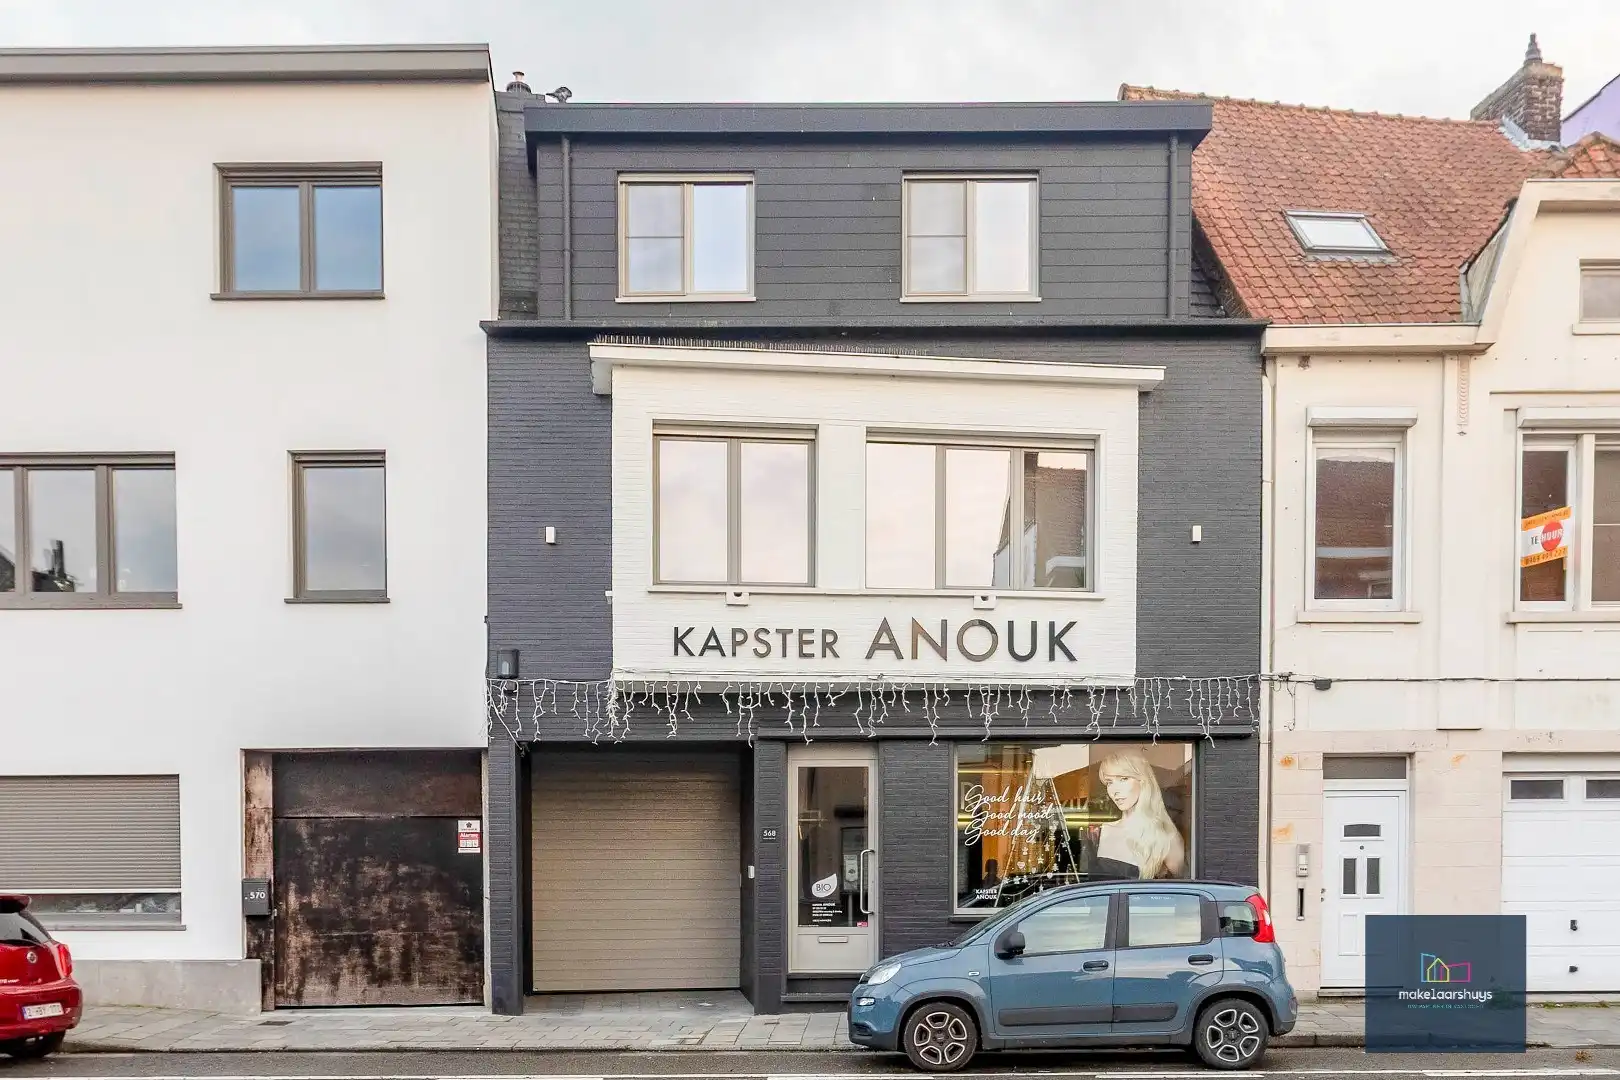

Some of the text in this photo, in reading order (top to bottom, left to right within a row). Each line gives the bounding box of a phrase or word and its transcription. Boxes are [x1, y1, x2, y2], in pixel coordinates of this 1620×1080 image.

[1531, 535, 1539, 545] TE
[673, 616, 1078, 662] KAPSTER ANOUK
[965, 784, 1010, 812] Good
[1014, 785, 1045, 804] hair
[972, 801, 1017, 828] Good
[763, 829, 777, 837] 568
[965, 818, 1041, 846] Good day
[250, 891, 266, 899] 570
[815, 883, 832, 892] BIO
